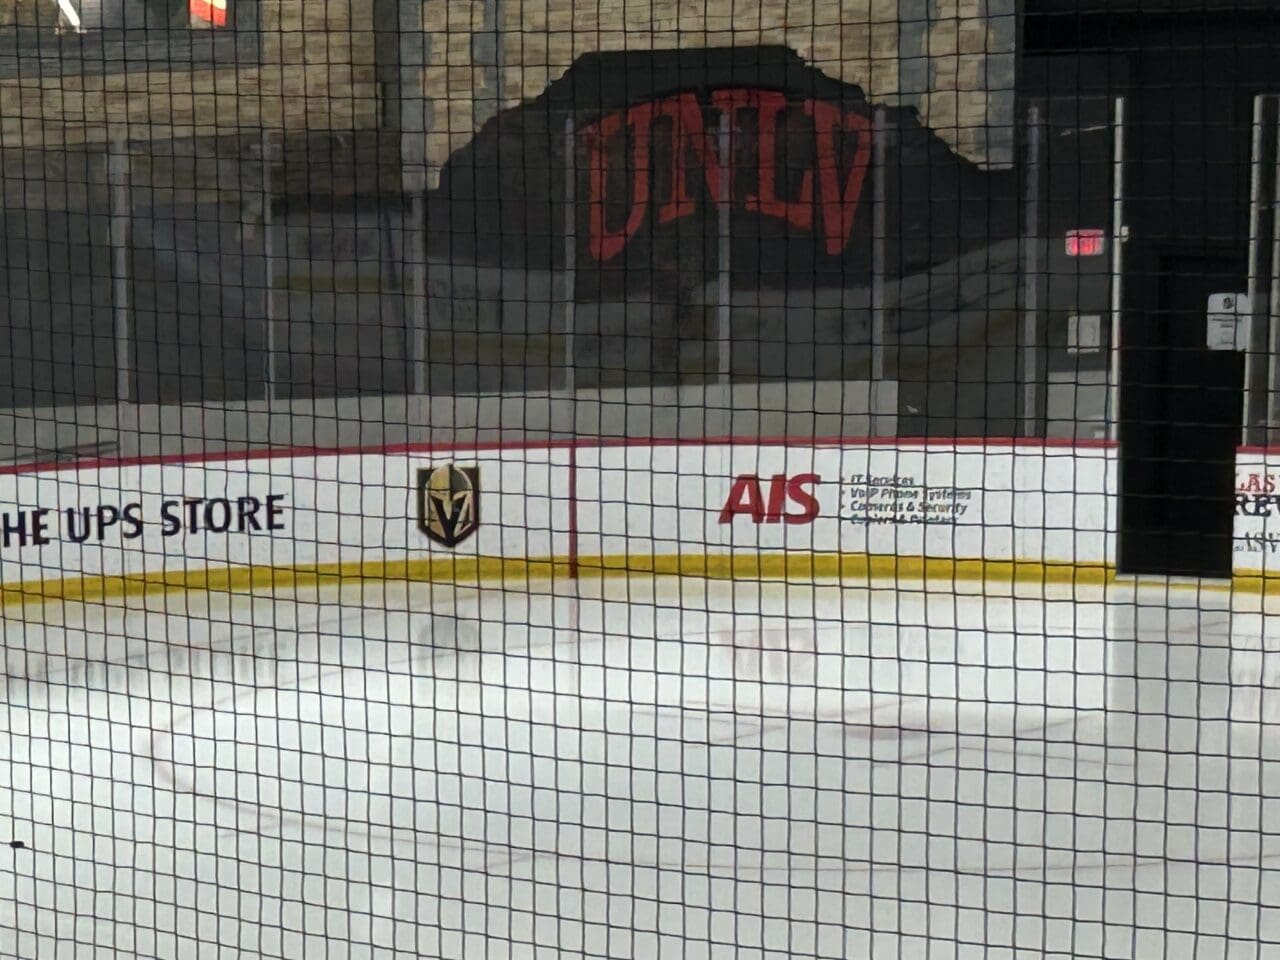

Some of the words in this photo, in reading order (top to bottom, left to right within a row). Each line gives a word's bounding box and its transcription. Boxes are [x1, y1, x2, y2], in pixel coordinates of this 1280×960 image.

[577, 86, 874, 261] UNLV
[66, 502, 144, 543] UPS
[160, 493, 287, 537] STORE
[718, 473, 822, 525] AIS
